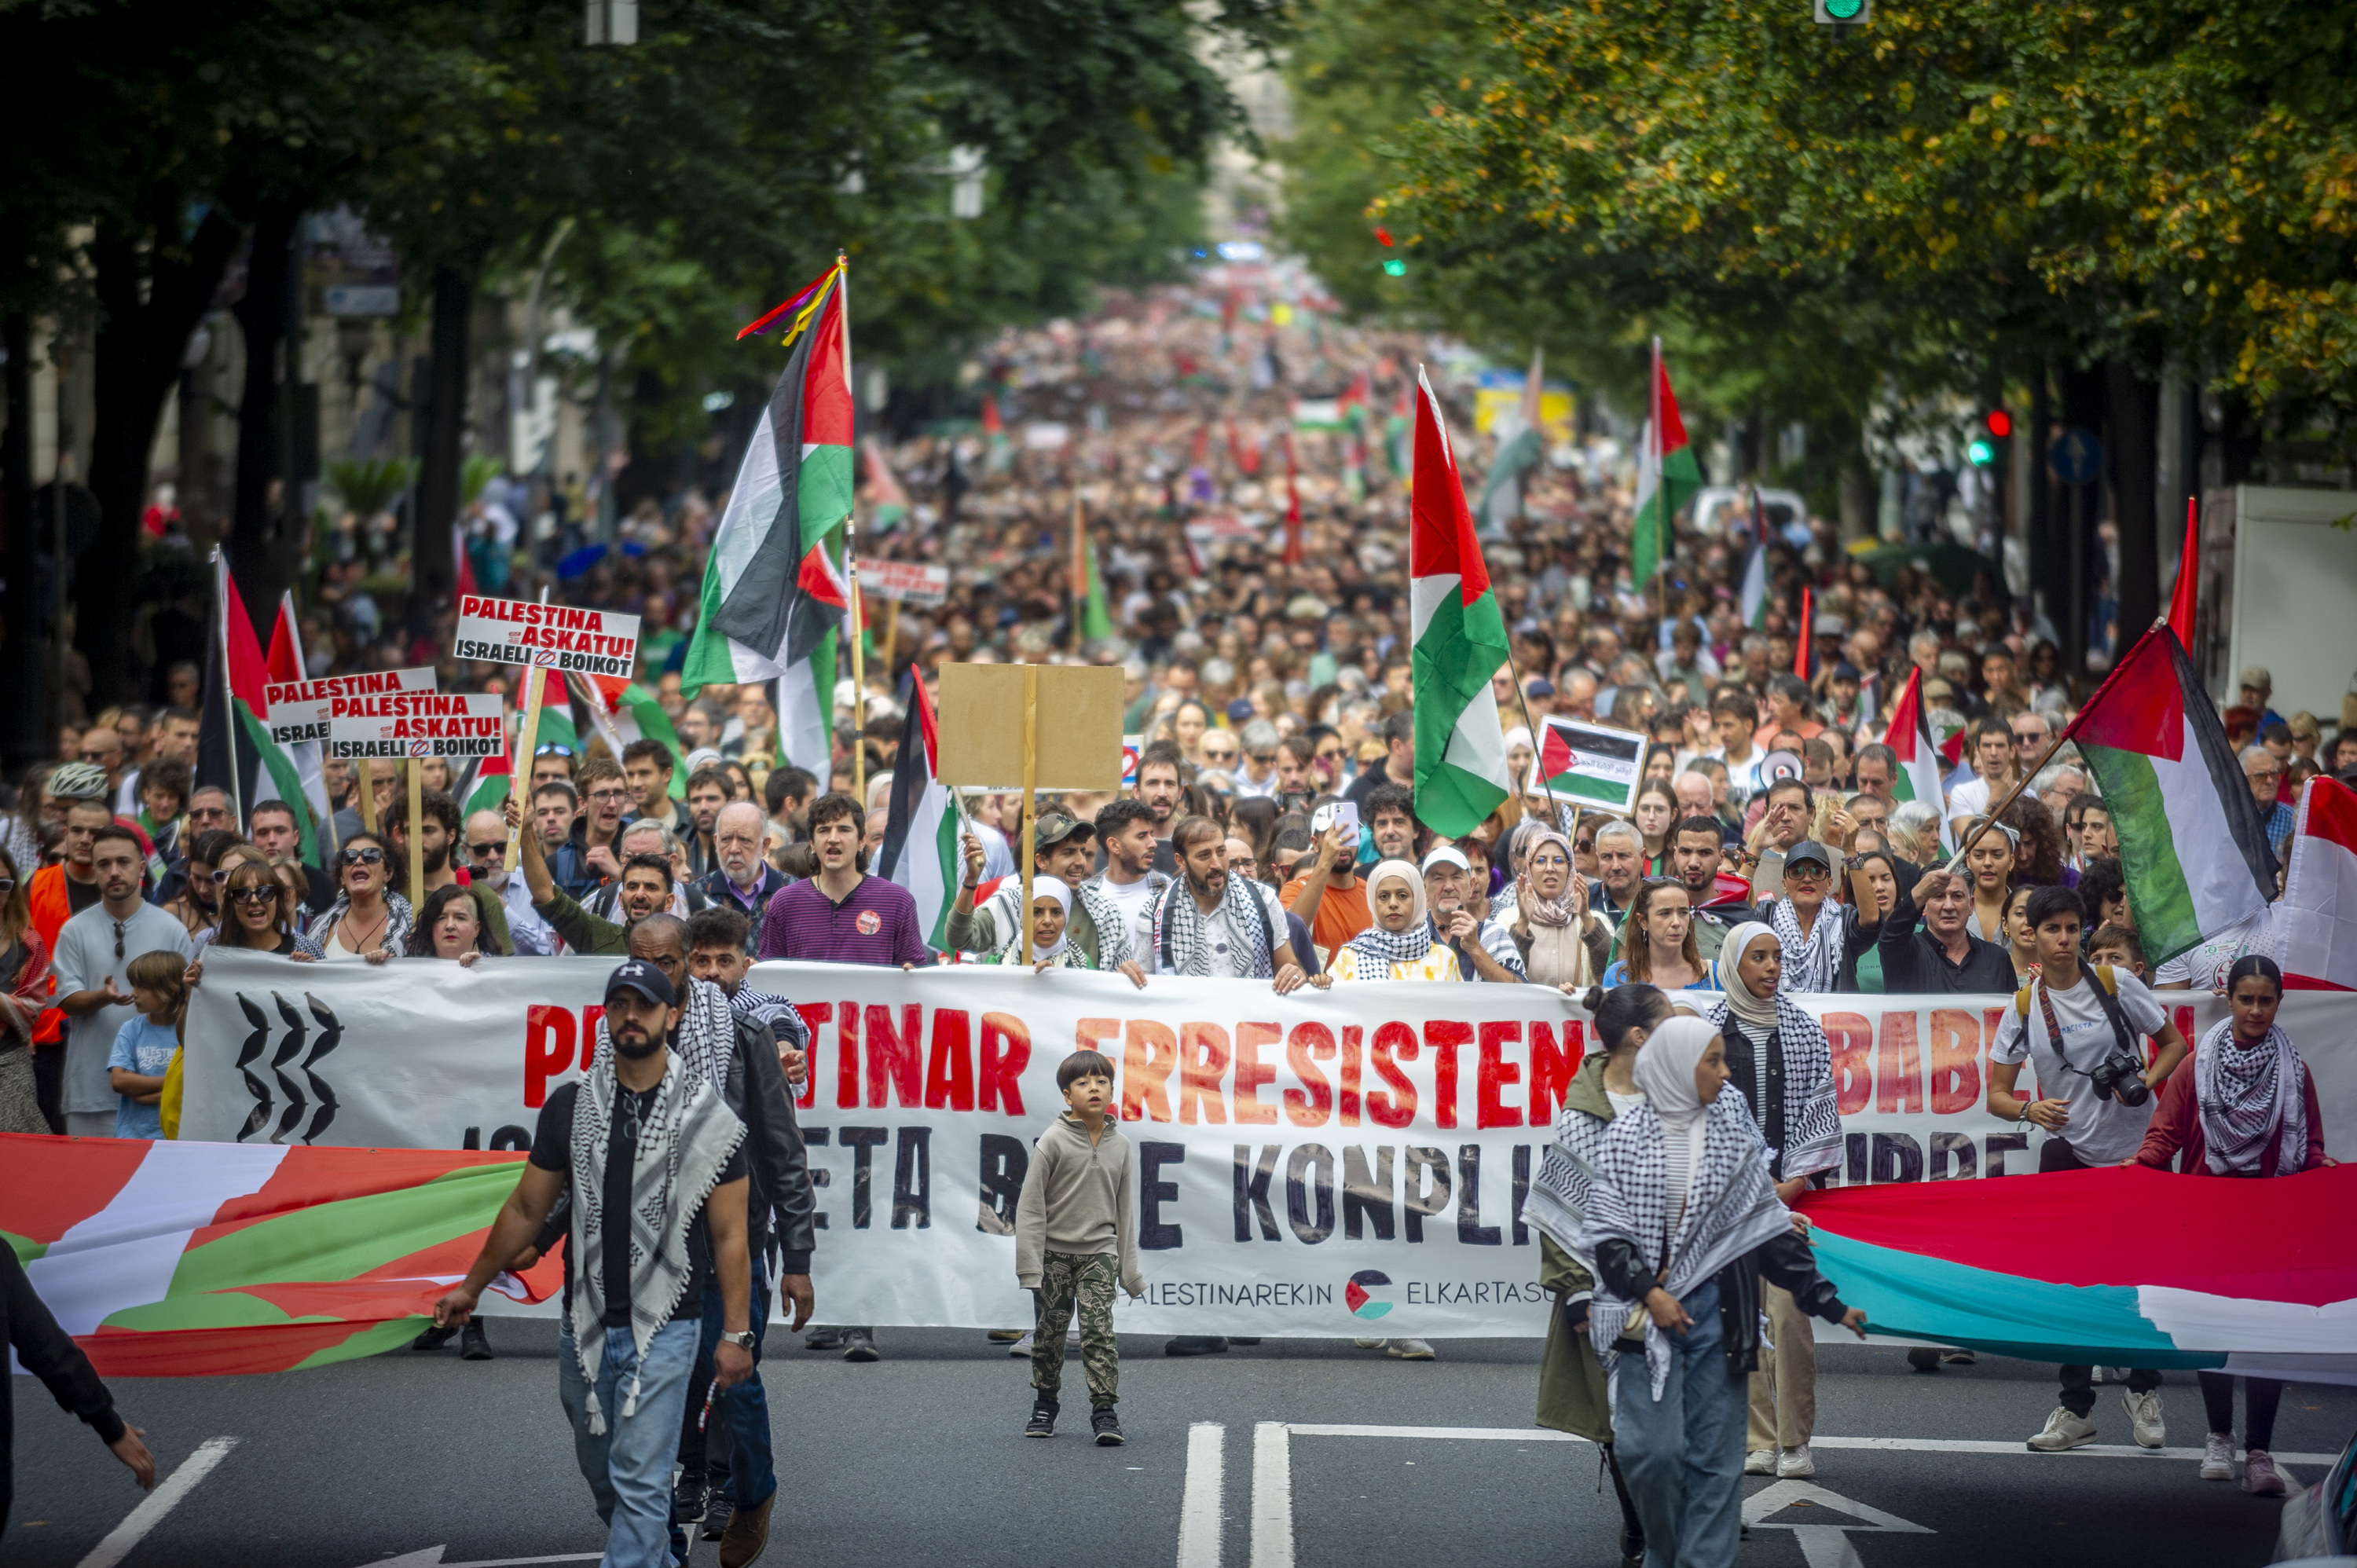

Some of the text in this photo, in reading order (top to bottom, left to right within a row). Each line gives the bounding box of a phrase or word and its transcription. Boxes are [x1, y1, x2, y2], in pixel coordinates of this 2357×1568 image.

[462, 596, 603, 633] PALESTINA
[520, 625, 635, 659] ASKATU!
[456, 639, 631, 676] ISRAELI BOIKOT
[267, 672, 403, 705] PALESTINA
[332, 695, 470, 718] PALESTINA
[272, 721, 331, 744] ISRAE
[393, 716, 501, 738] ASKATU!
[332, 738, 501, 758] ISRAELI BOIKOT
[1153, 891, 1168, 955] ESTINE
[2051, 1021, 2093, 1036] RACISTA
[136, 1047, 177, 1060] PALESTIN
[524, 1001, 1032, 1117] PTINAR
[1076, 1017, 1602, 1129] ERRESISTEN
[976, 1133, 1186, 1251] BE
[1233, 1142, 1550, 1247] KONPLI
[1116, 1280, 1556, 1307] PALESTINAREKIN ELKARTASU
